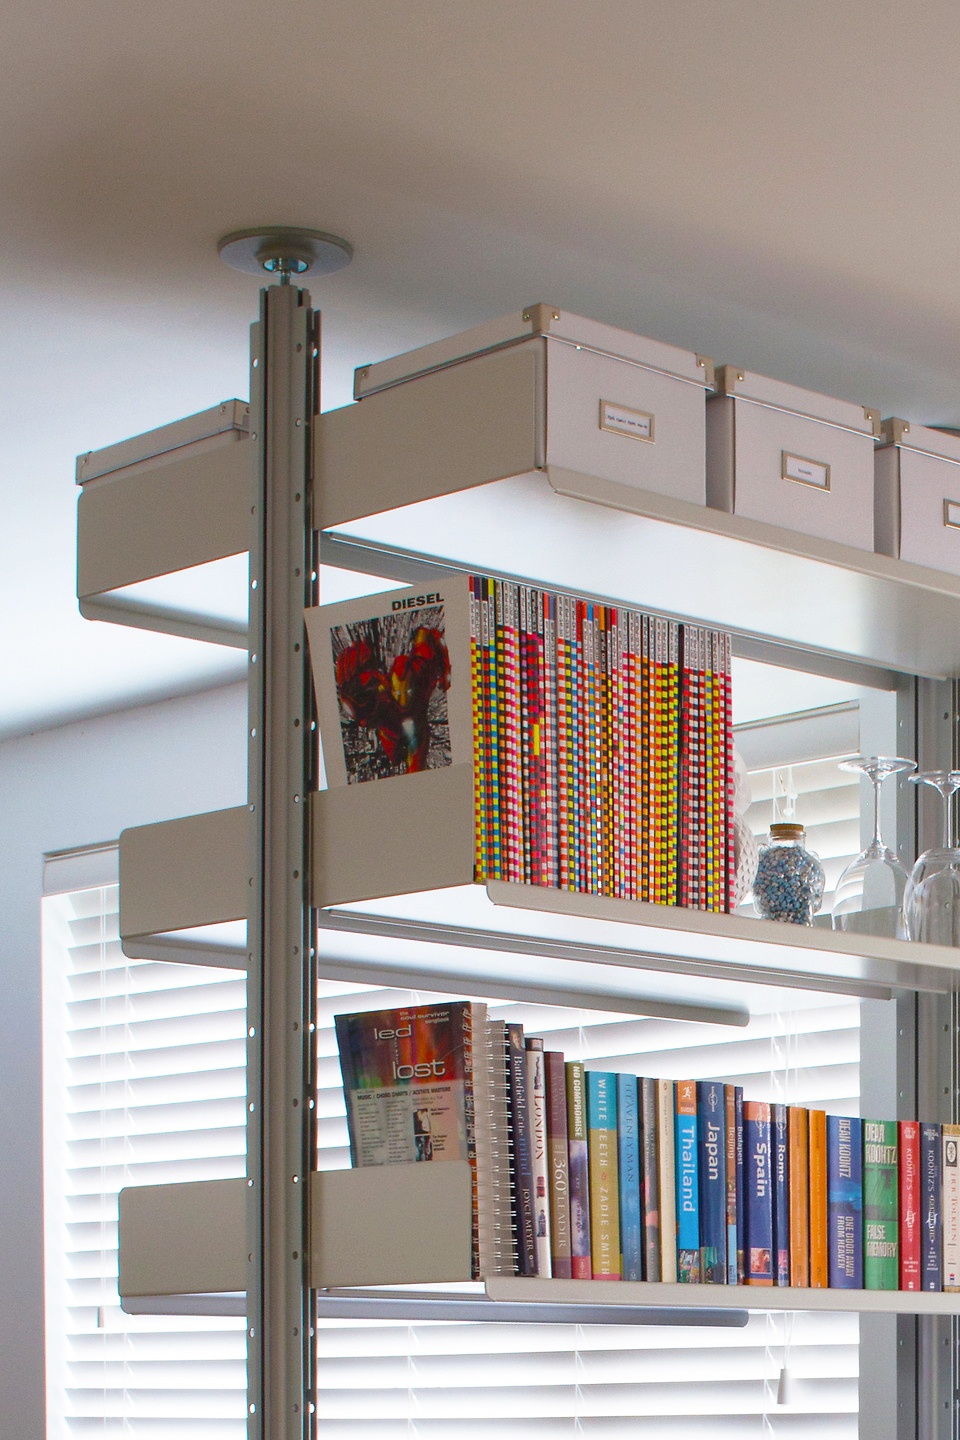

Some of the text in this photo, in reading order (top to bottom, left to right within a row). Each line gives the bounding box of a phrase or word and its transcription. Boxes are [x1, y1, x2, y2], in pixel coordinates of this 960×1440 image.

[392, 592, 445, 611] DIESEL
[374, 1024, 412, 1040] led
[417, 1010, 450, 1020] survivor
[392, 1060, 446, 1080] lost
[514, 1056, 532, 1176] Battlefield of the mind
[573, 1065, 583, 1138] NO COMPROMISE
[534, 1095, 545, 1160] LONDON
[625, 1082, 634, 1182] HEAVENLY MAN
[705, 1122, 720, 1180] Japan
[727, 1126, 736, 1159] Beijing
[736, 1126, 744, 1165] Budapest
[838, 1119, 852, 1179] DEAN KOONTZ
[864, 1123, 885, 1143] DEAN
[598, 1079, 611, 1275] WHITE TEETH ZADIE SMITH
[682, 1126, 696, 1212] Thailand
[753, 1143, 768, 1197] Spain
[778, 1144, 786, 1183] Rome
[864, 1143, 897, 1165] KOONTZ
[905, 1148, 913, 1191] KOONTZ'S
[927, 1149, 935, 1192] KOONTZ'S
[522, 1188, 534, 1252] JOYCE MEYER
[557, 1197, 567, 1248] LEADER
[837, 1215, 846, 1269] FROM HEAVEN
[866, 1224, 886, 1240] FALSE
[845, 1216, 855, 1278] ONE DOOR AWAY
[866, 1241, 898, 1258] MEMORY
